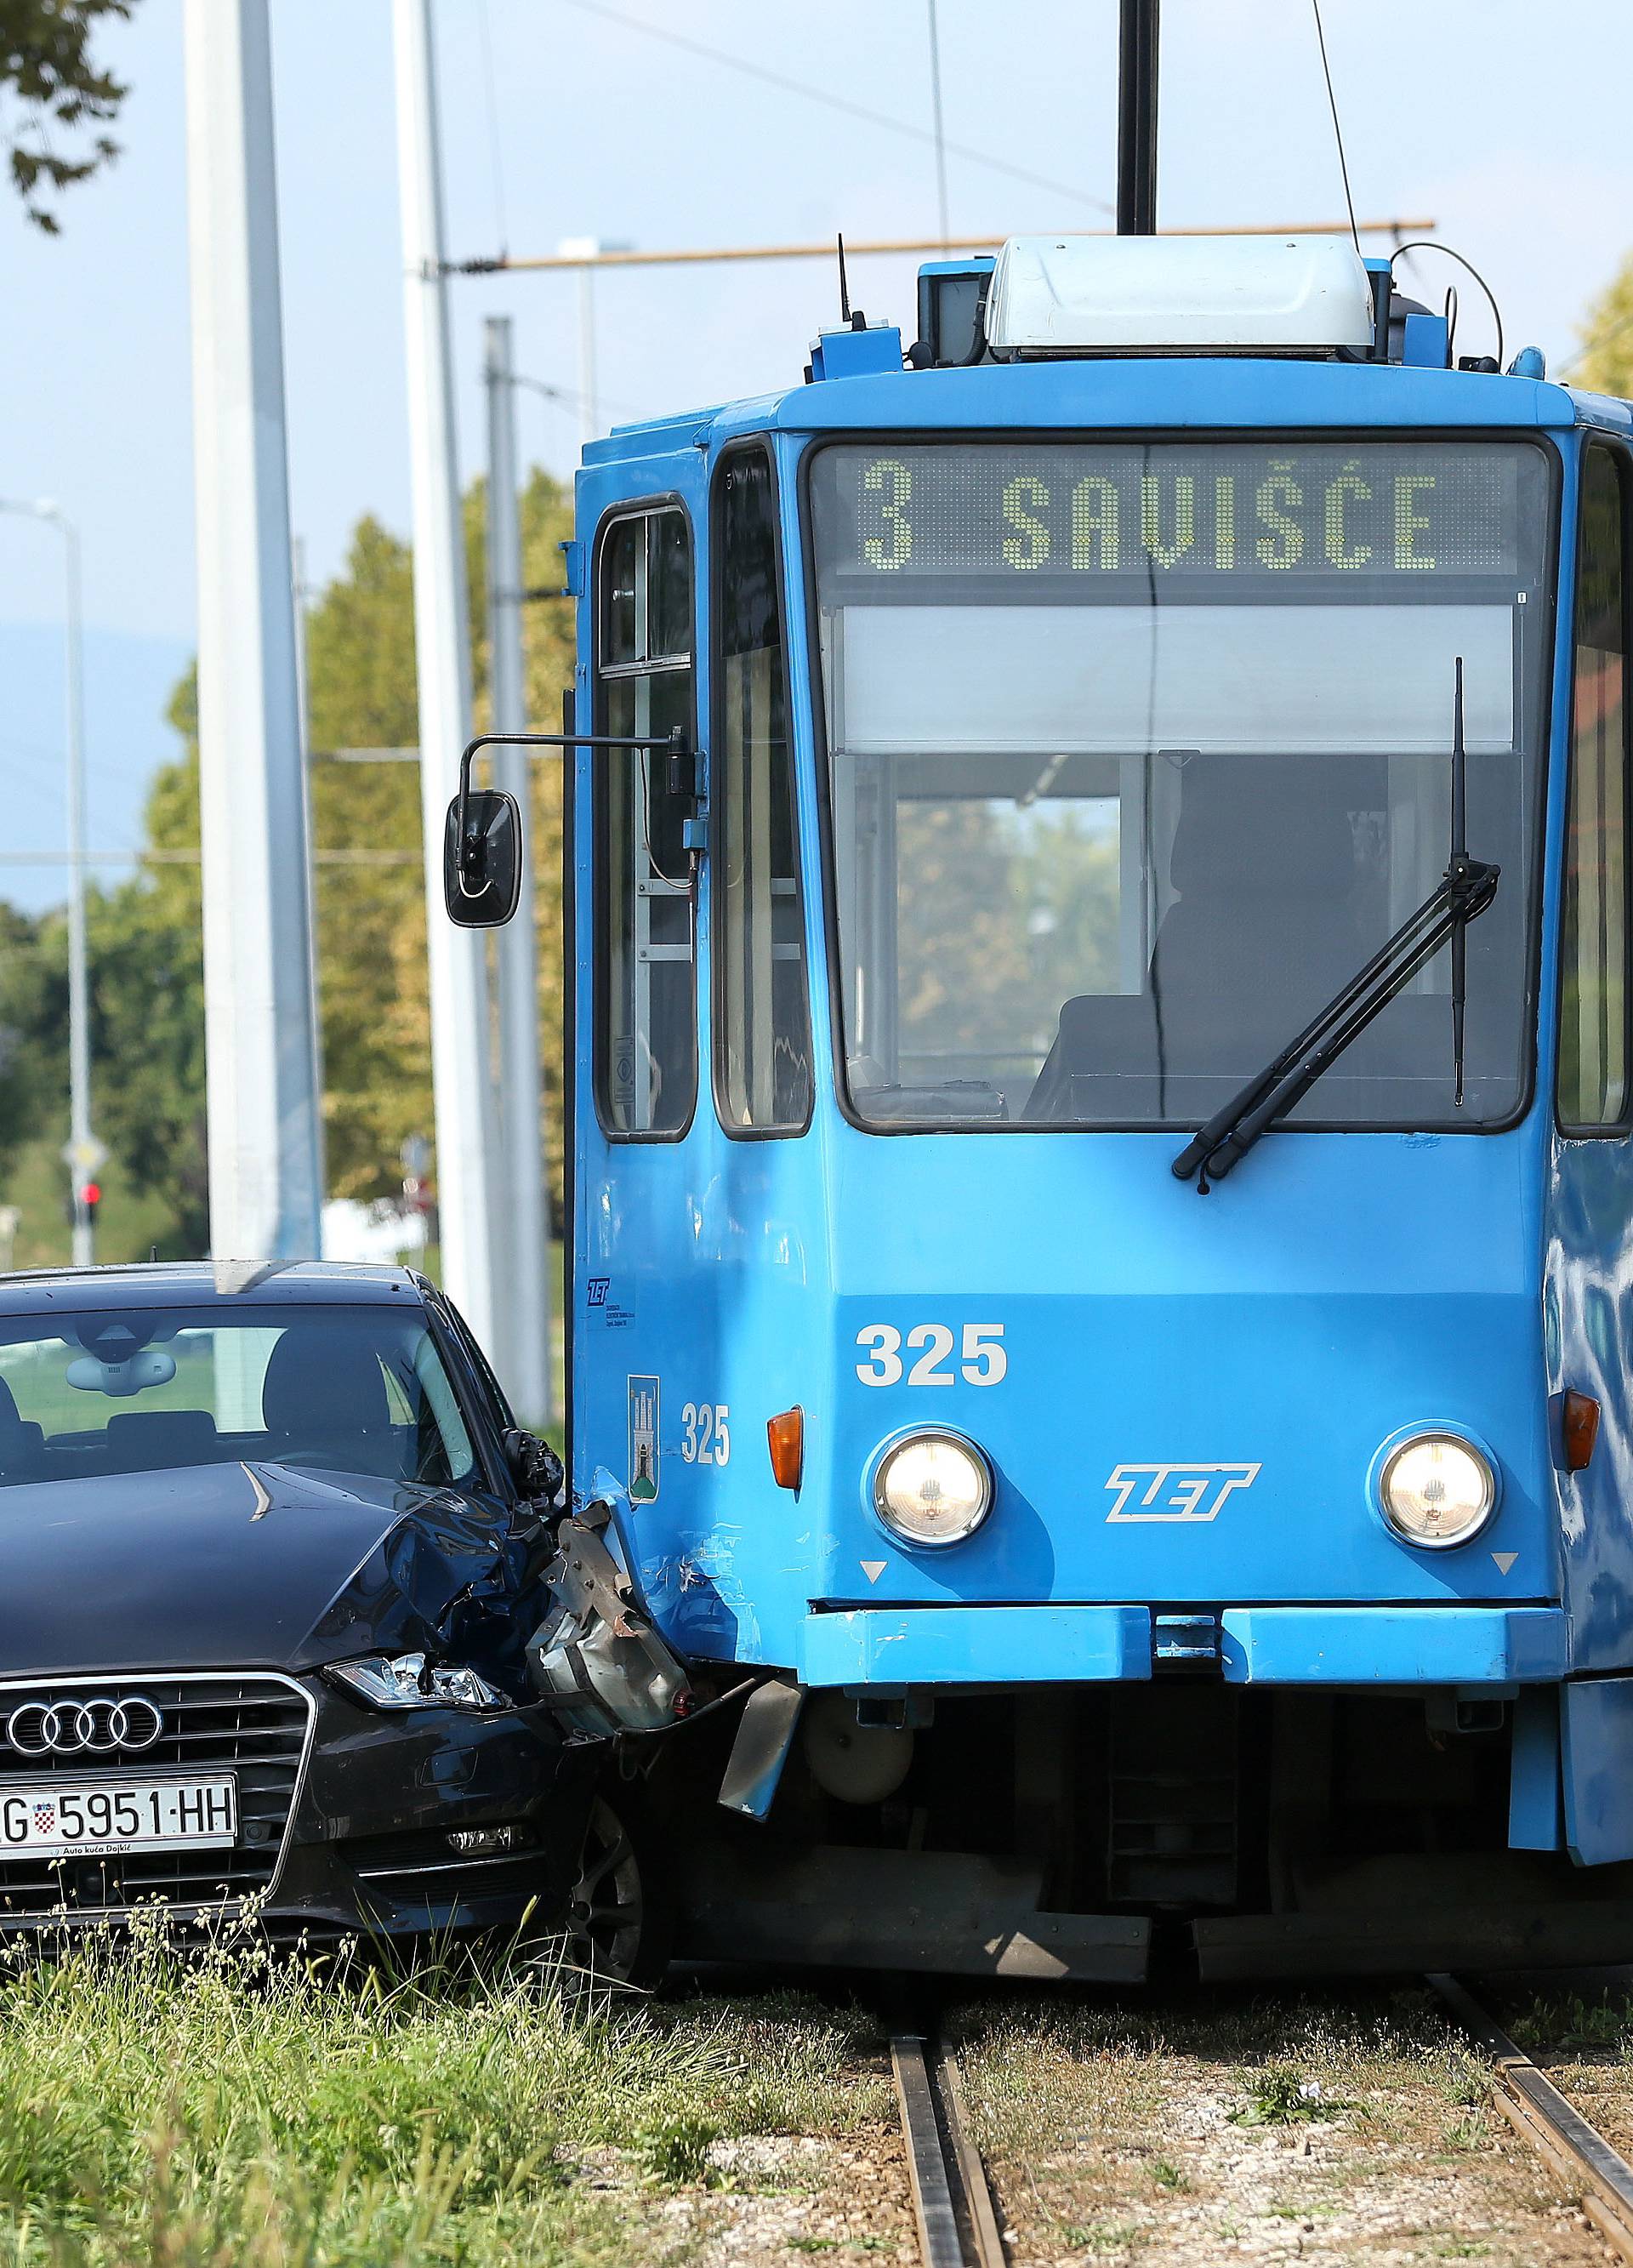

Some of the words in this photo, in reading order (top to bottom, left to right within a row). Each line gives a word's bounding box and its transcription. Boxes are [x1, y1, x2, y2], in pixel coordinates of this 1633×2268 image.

[864, 459, 913, 571] 3
[1002, 458, 1437, 571] SAVIŠĆE
[587, 1277, 611, 1307] ZET
[856, 1324, 1007, 1387] 325
[681, 1402, 731, 1467] 325
[1104, 1462, 1263, 1523] ZET
[0, 1797, 28, 1843] G
